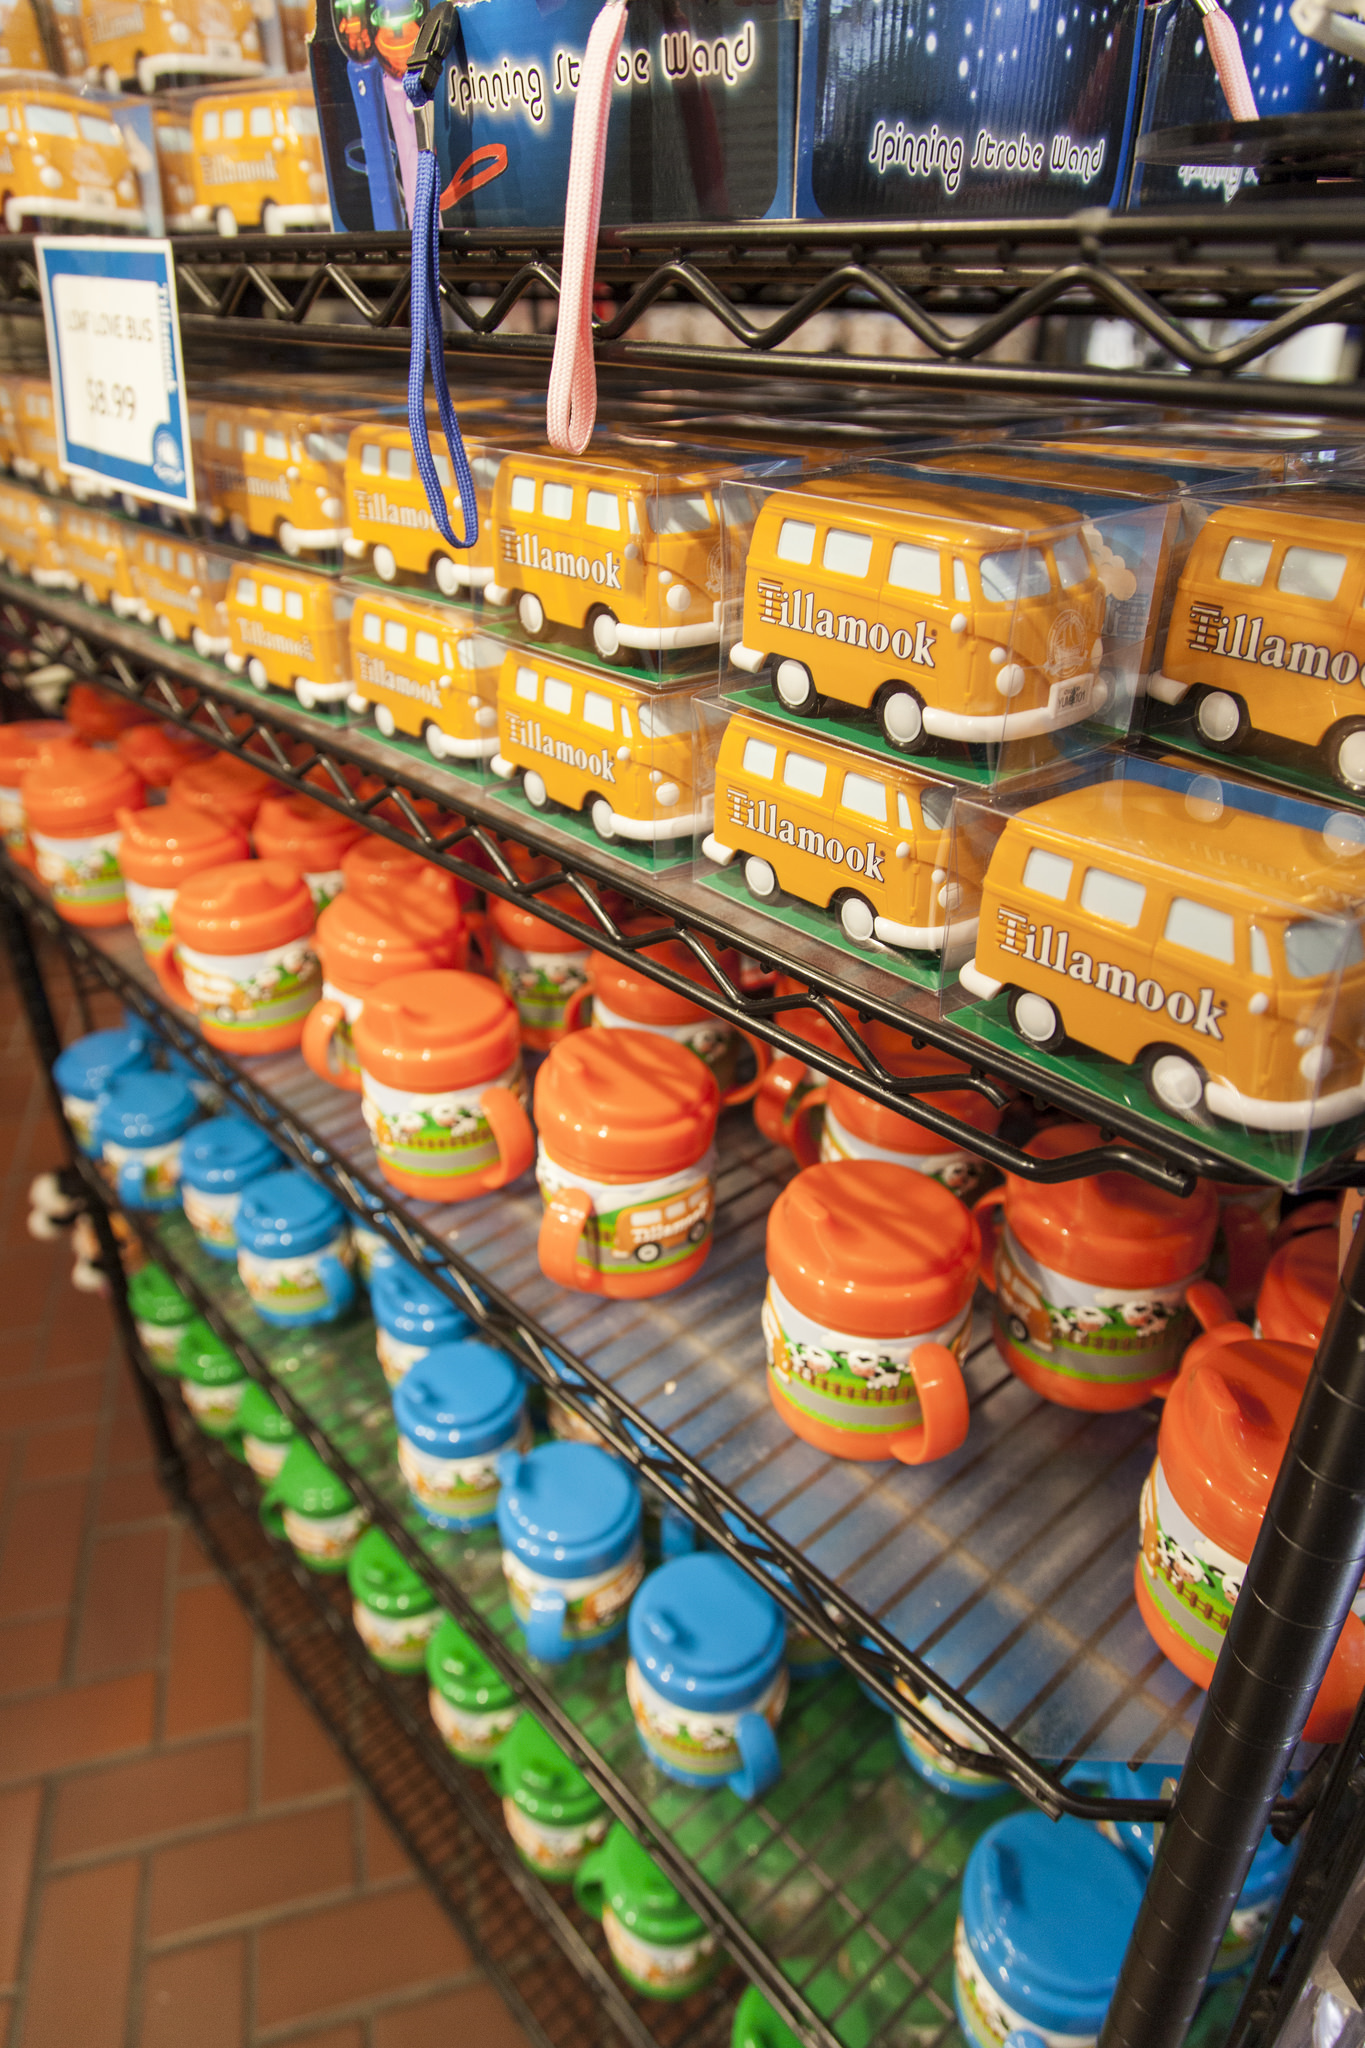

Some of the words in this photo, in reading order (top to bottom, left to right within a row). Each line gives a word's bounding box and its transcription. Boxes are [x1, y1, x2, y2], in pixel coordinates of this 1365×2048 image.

[449, 57, 545, 125] Spinning
[553, 49, 651, 94] Stbe
[661, 21, 755, 86] Wand
[869, 120, 963, 194] Spinning
[971, 129, 1044, 171] Strobe
[1051, 135, 1105, 183] Wand
[86, 376, 136, 421] $8.99
[500, 528, 622, 590] Tillamook
[757, 578, 937, 668] Tillamook
[1186, 601, 1365, 687] Tillamo
[356, 651, 444, 710] Tillamook
[505, 711, 617, 784] Tillamook
[727, 785, 885, 884] Tillamook
[996, 905, 1227, 1042] Tillamook
